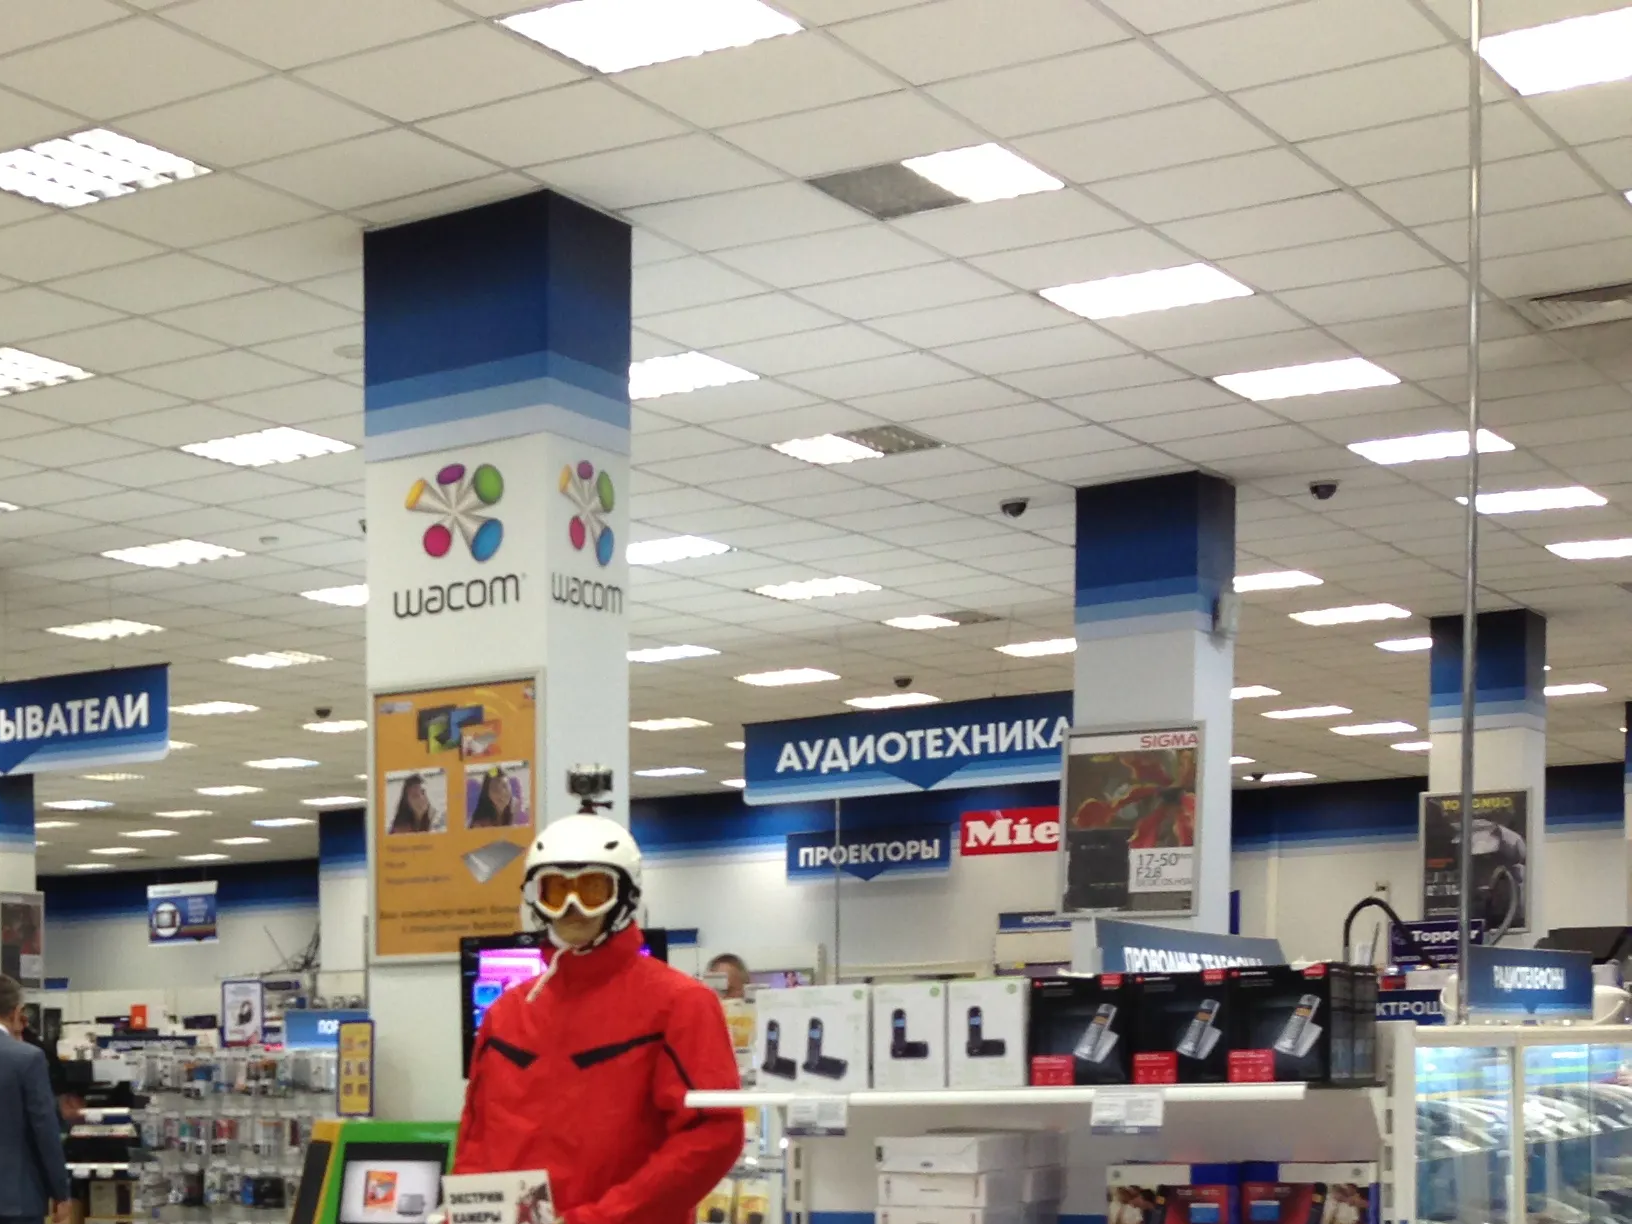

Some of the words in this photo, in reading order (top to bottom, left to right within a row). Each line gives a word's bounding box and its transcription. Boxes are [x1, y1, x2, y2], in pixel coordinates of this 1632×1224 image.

[394, 573, 520, 619] wacom
[552, 572, 622, 615] wacom
[776, 716, 1070, 774] АУДИОТЕХНИКА
[1140, 733, 1199, 749] SIGMA
[966, 817, 1060, 848] Mie
[799, 839, 940, 867] ПРОЕКТОРЫ
